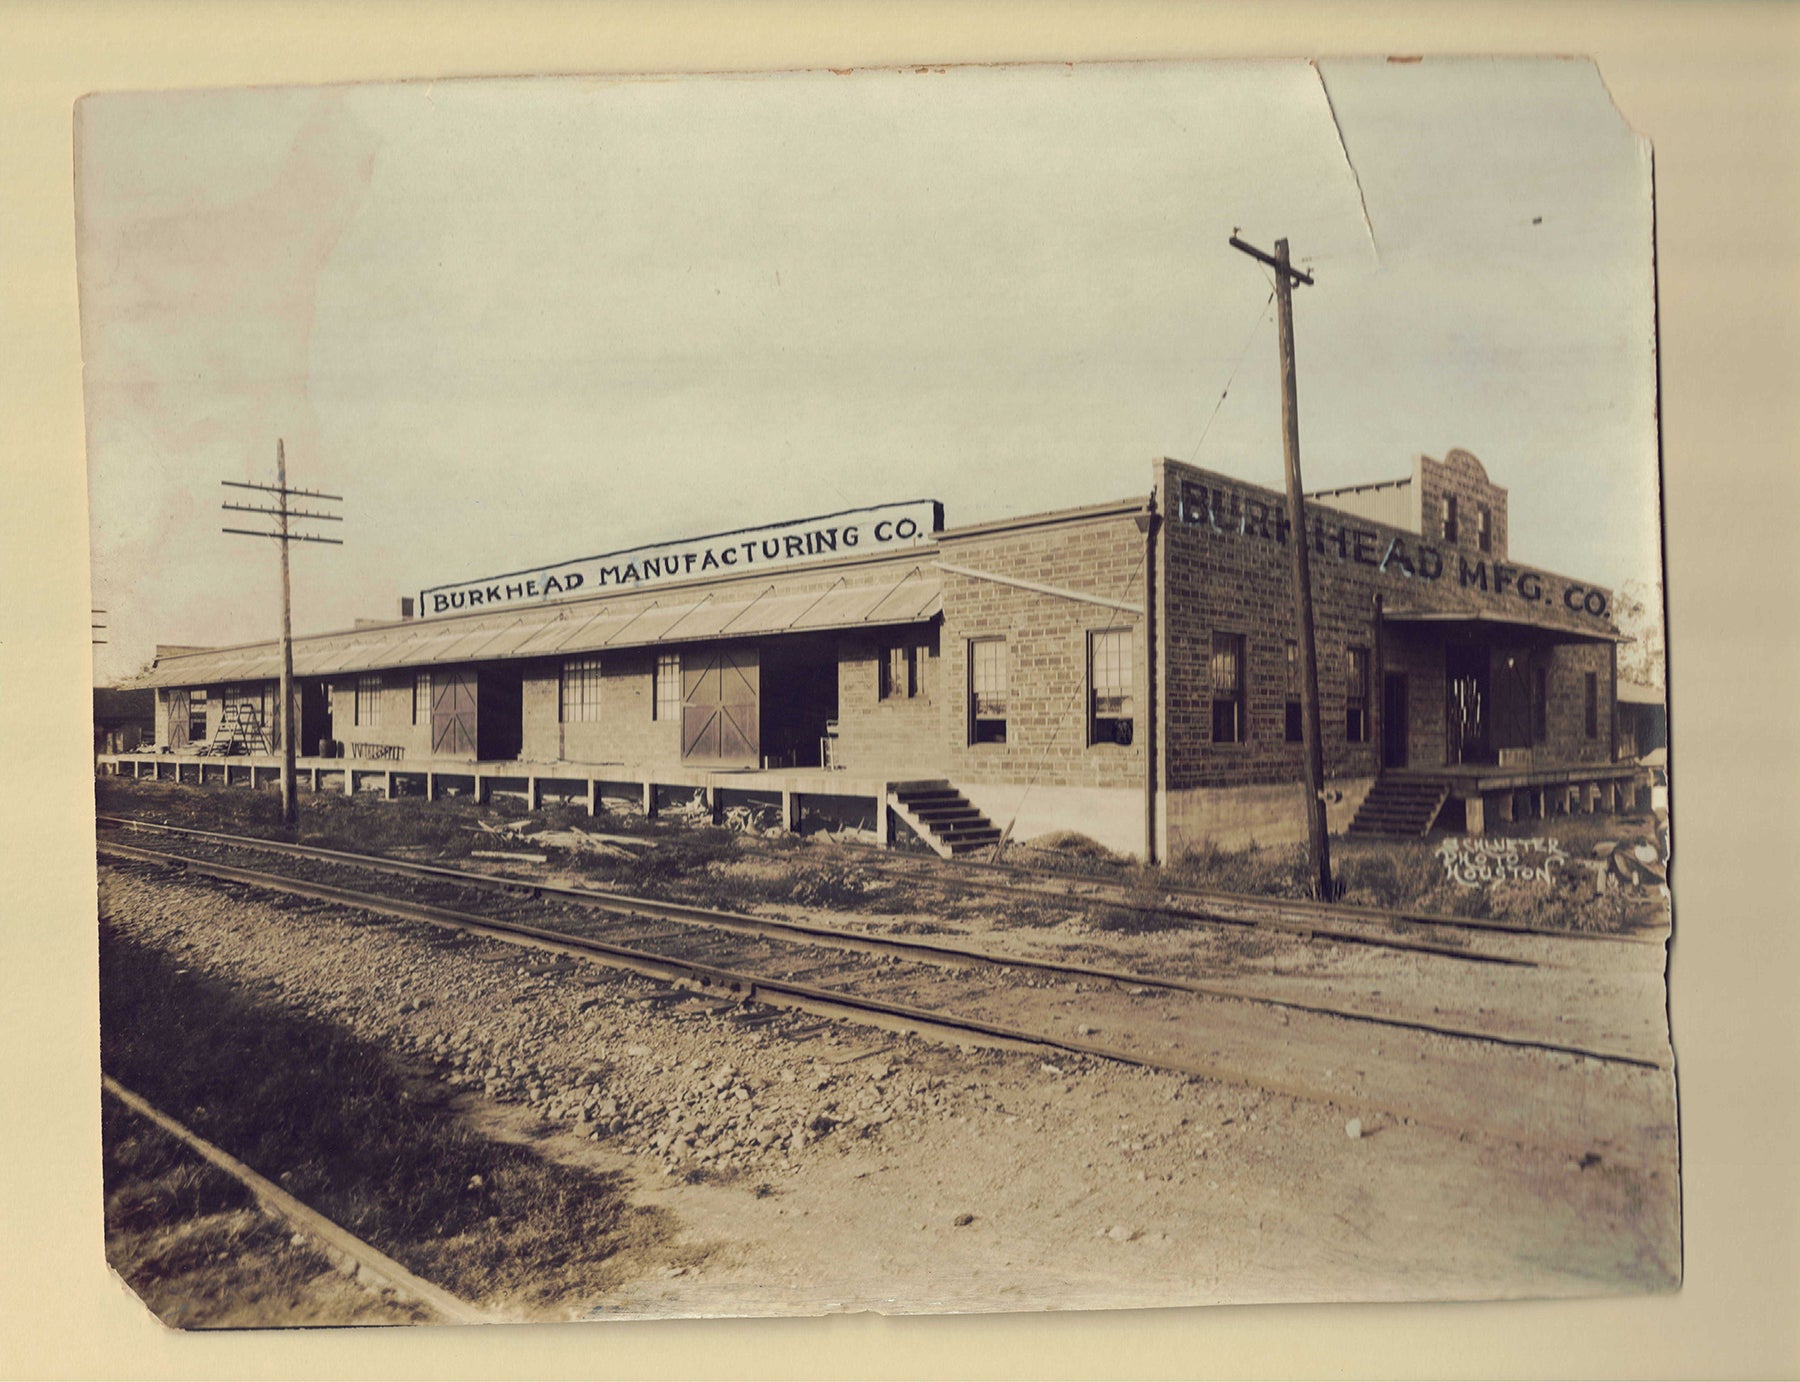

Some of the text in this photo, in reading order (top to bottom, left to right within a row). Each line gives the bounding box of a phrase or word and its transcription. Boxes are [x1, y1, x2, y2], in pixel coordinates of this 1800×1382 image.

[434, 518, 924, 613] BURKHEAD MANUFACTURING CO.
[1459, 558, 1552, 606] MFG.
[1563, 584, 1611, 619] CO.
